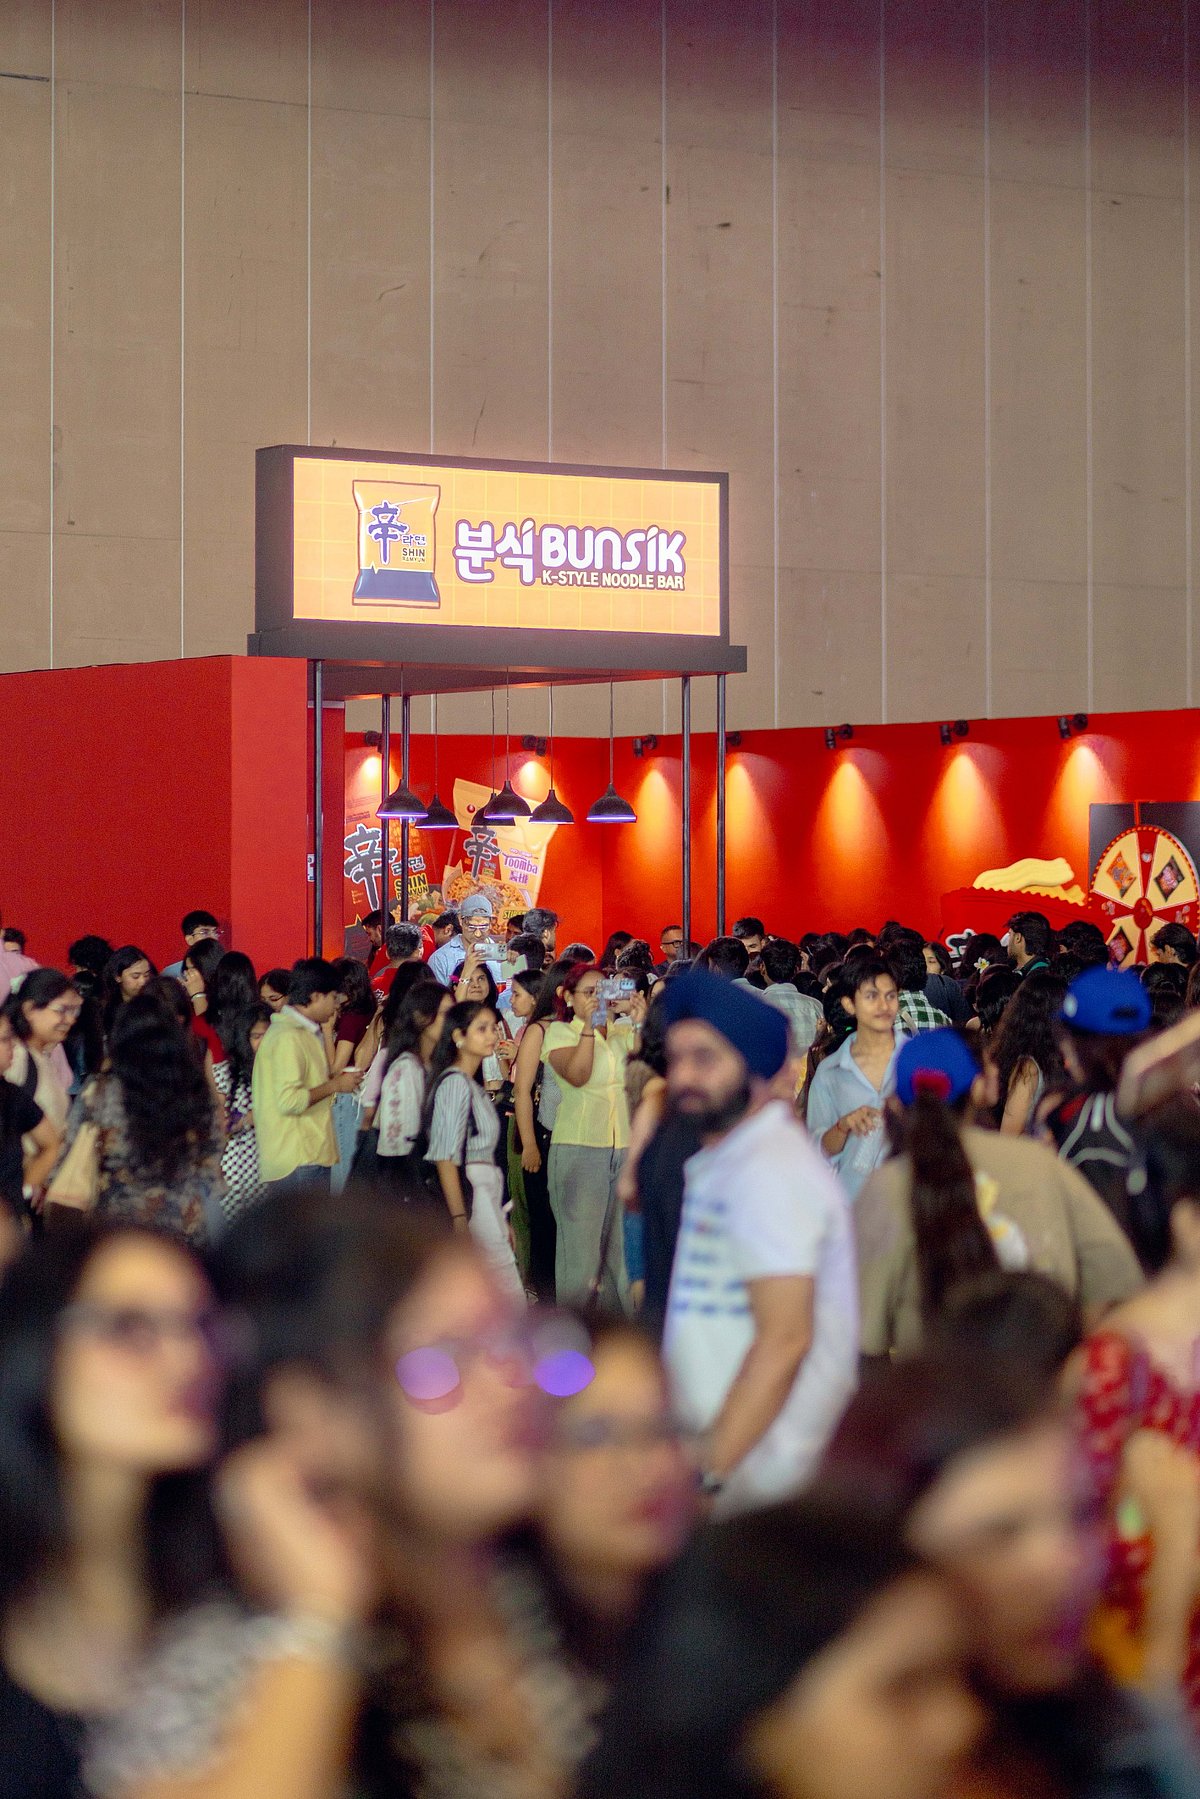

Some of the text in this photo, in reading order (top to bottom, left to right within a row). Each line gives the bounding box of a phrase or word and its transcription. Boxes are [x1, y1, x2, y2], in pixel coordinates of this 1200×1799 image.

[367, 500, 408, 564] 辛
[402, 547, 425, 558] SHIN
[455, 519, 535, 583] 분식
[542, 570, 684, 590] K-STYLE NOODLE BAR
